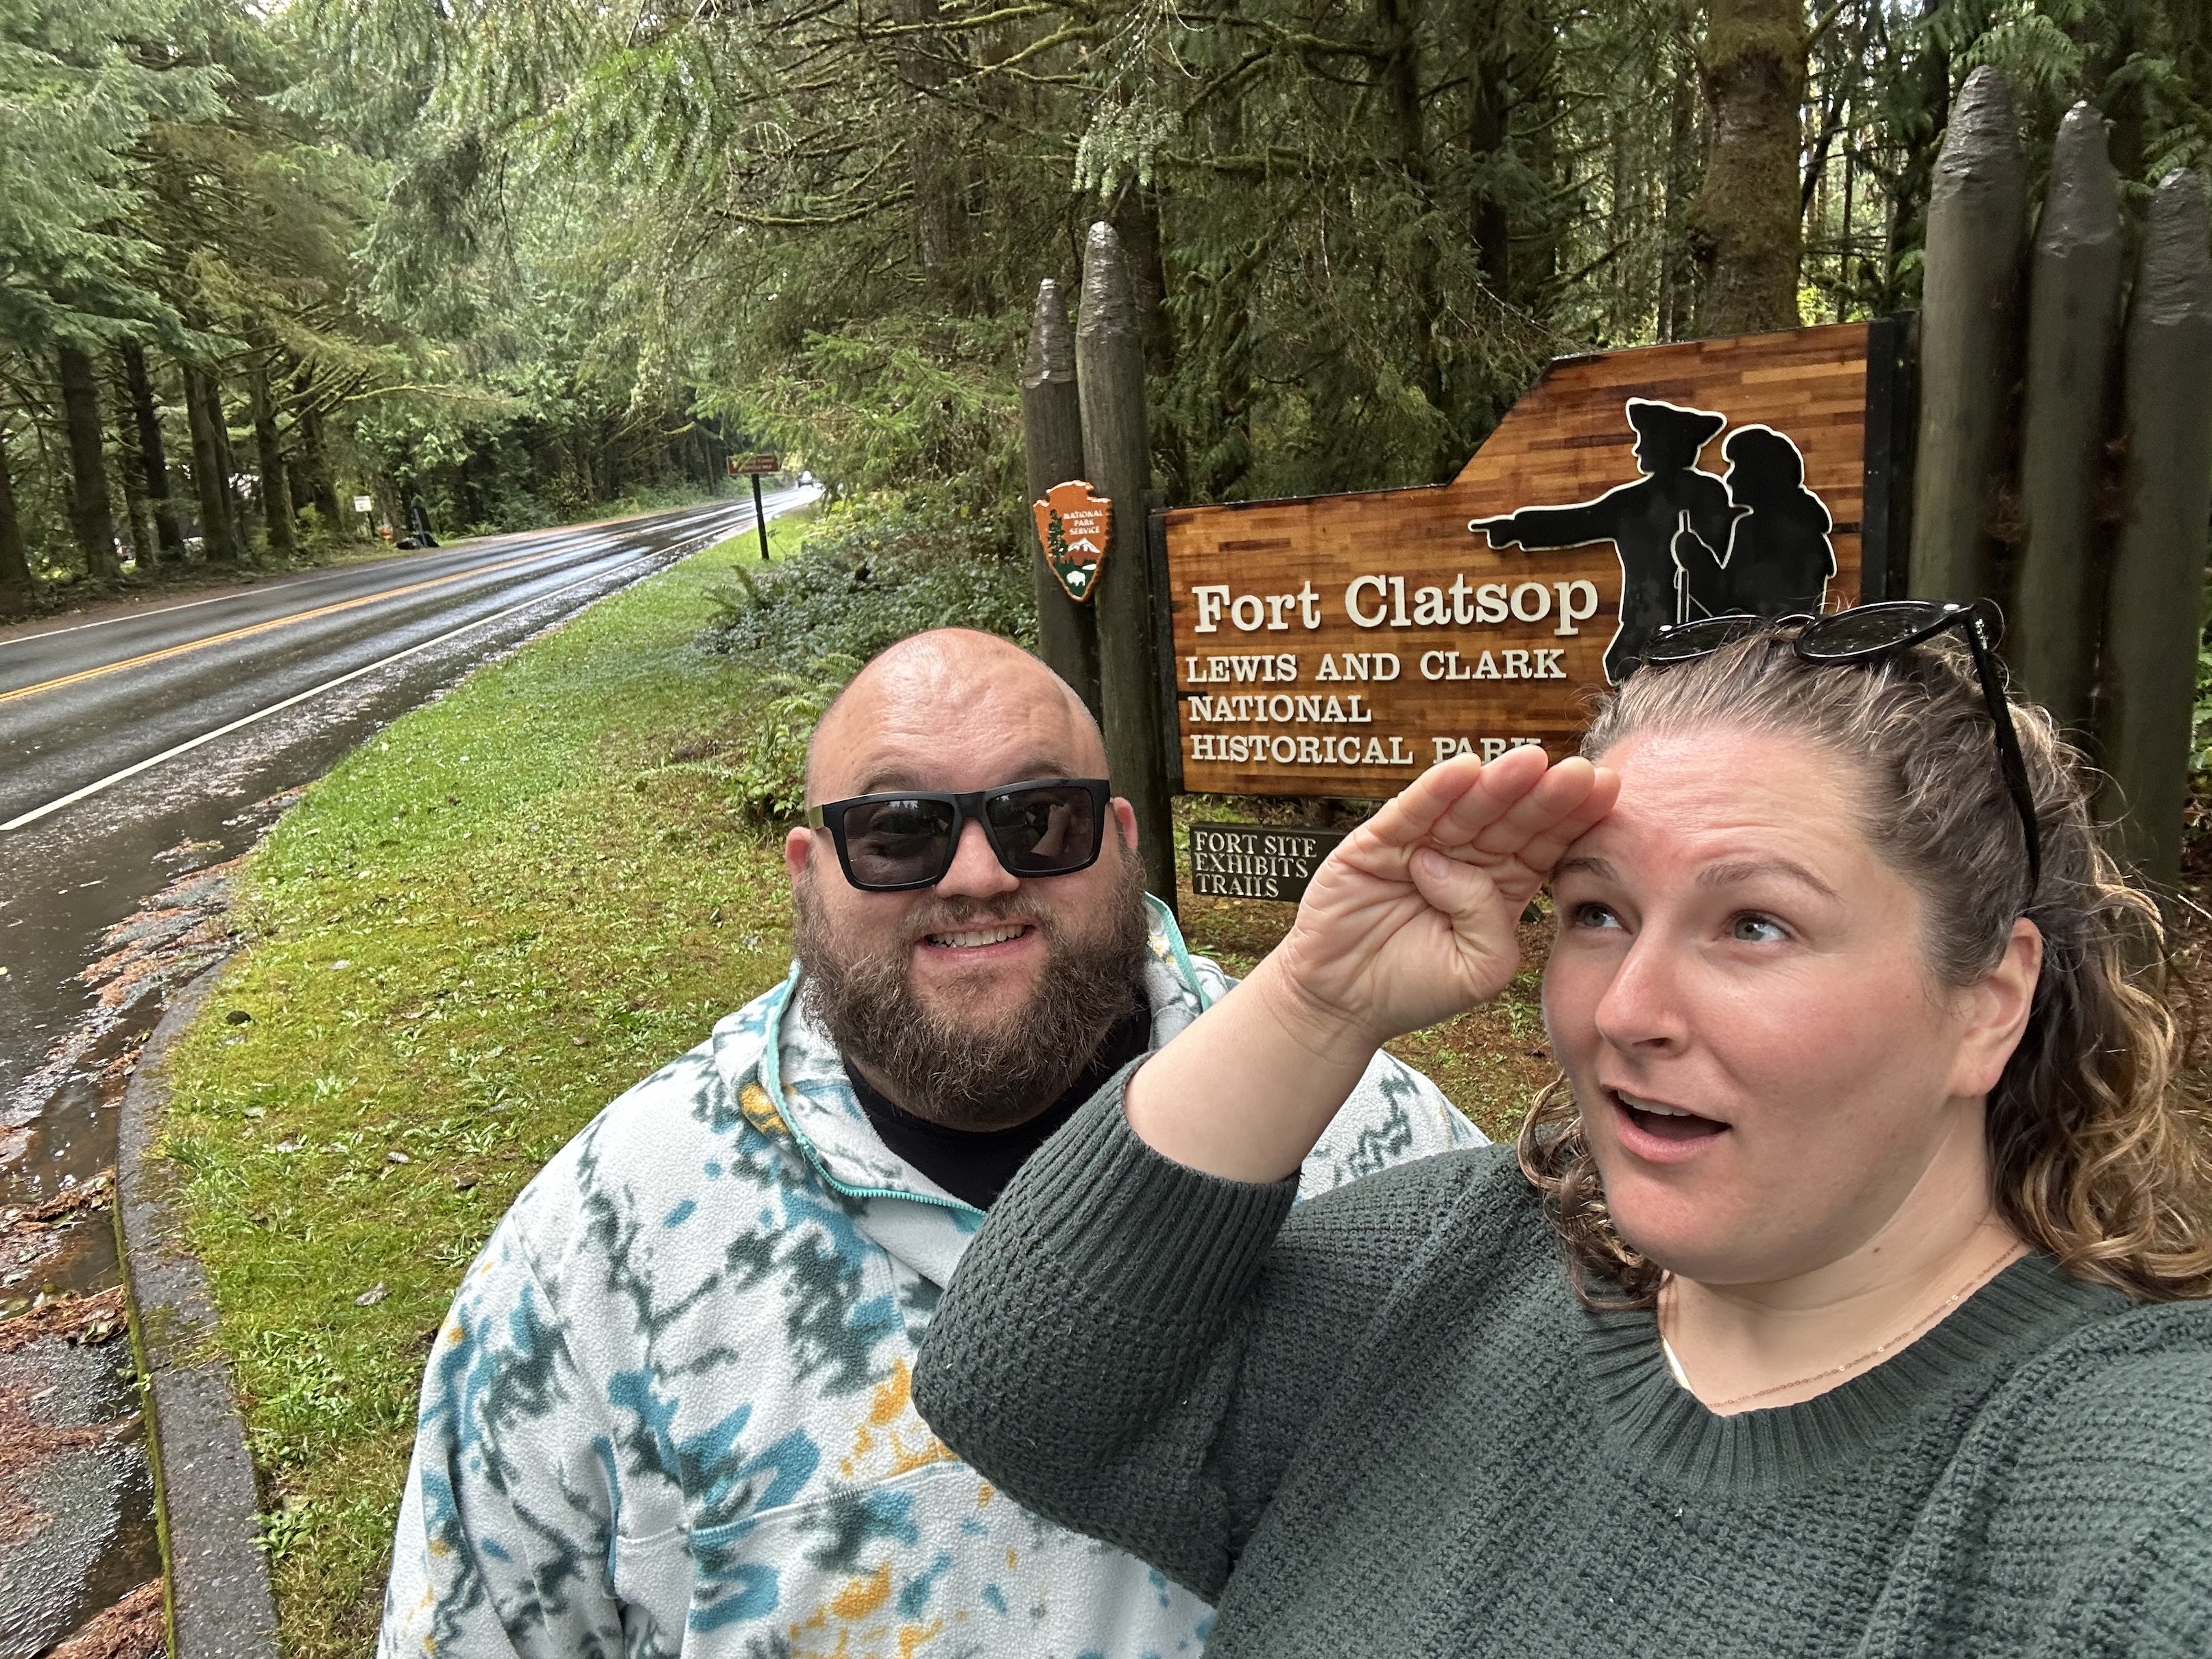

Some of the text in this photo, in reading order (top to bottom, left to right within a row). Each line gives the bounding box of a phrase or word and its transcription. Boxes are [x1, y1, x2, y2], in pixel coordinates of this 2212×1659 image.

[1063, 510, 1103, 520] NATIONAL
[1074, 518, 1094, 527] PARK
[1069, 526, 1100, 535] SERVICE
[1192, 574, 1599, 636] Fort Clatsop
[1186, 649, 1567, 683] LEWIS AND CLARK
[1188, 695, 1371, 723] NATIONAL
[1190, 735, 1541, 765] HISTORICAL PAR
[1194, 831, 1317, 858] FORT SITE
[1194, 852, 1308, 879] EXHIBITS
[1196, 873, 1279, 898] TRAILS
